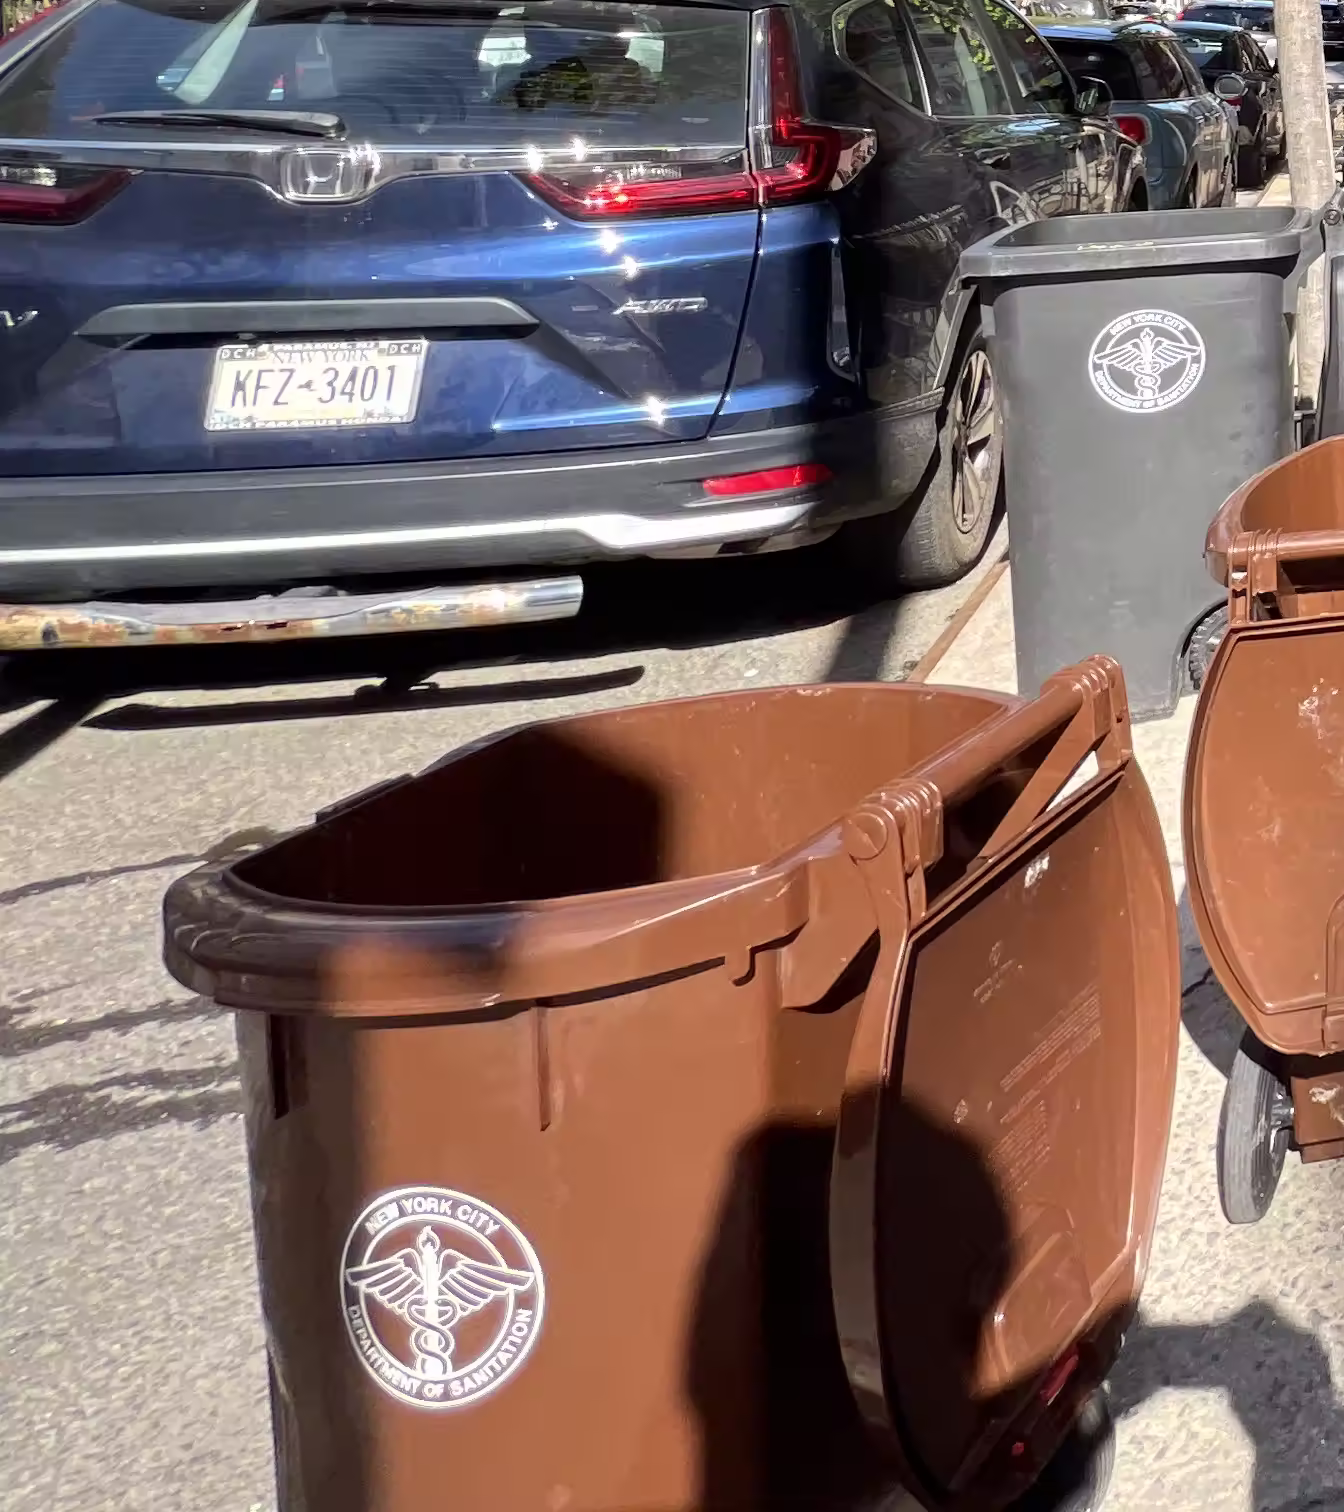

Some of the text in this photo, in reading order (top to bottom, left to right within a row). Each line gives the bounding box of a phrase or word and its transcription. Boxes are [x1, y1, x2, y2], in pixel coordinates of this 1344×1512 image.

[1109, 313, 1187, 335] NEW YORK CITY
[221, 348, 256, 359] DCH
[323, 348, 370, 363] YORK
[389, 344, 422, 354] DCH
[231, 365, 397, 408] KFZ 3401
[365, 1197, 500, 1236] NEW YORK CITY
[349, 1305, 533, 1399] DEPARTMENT OF SANITATION
